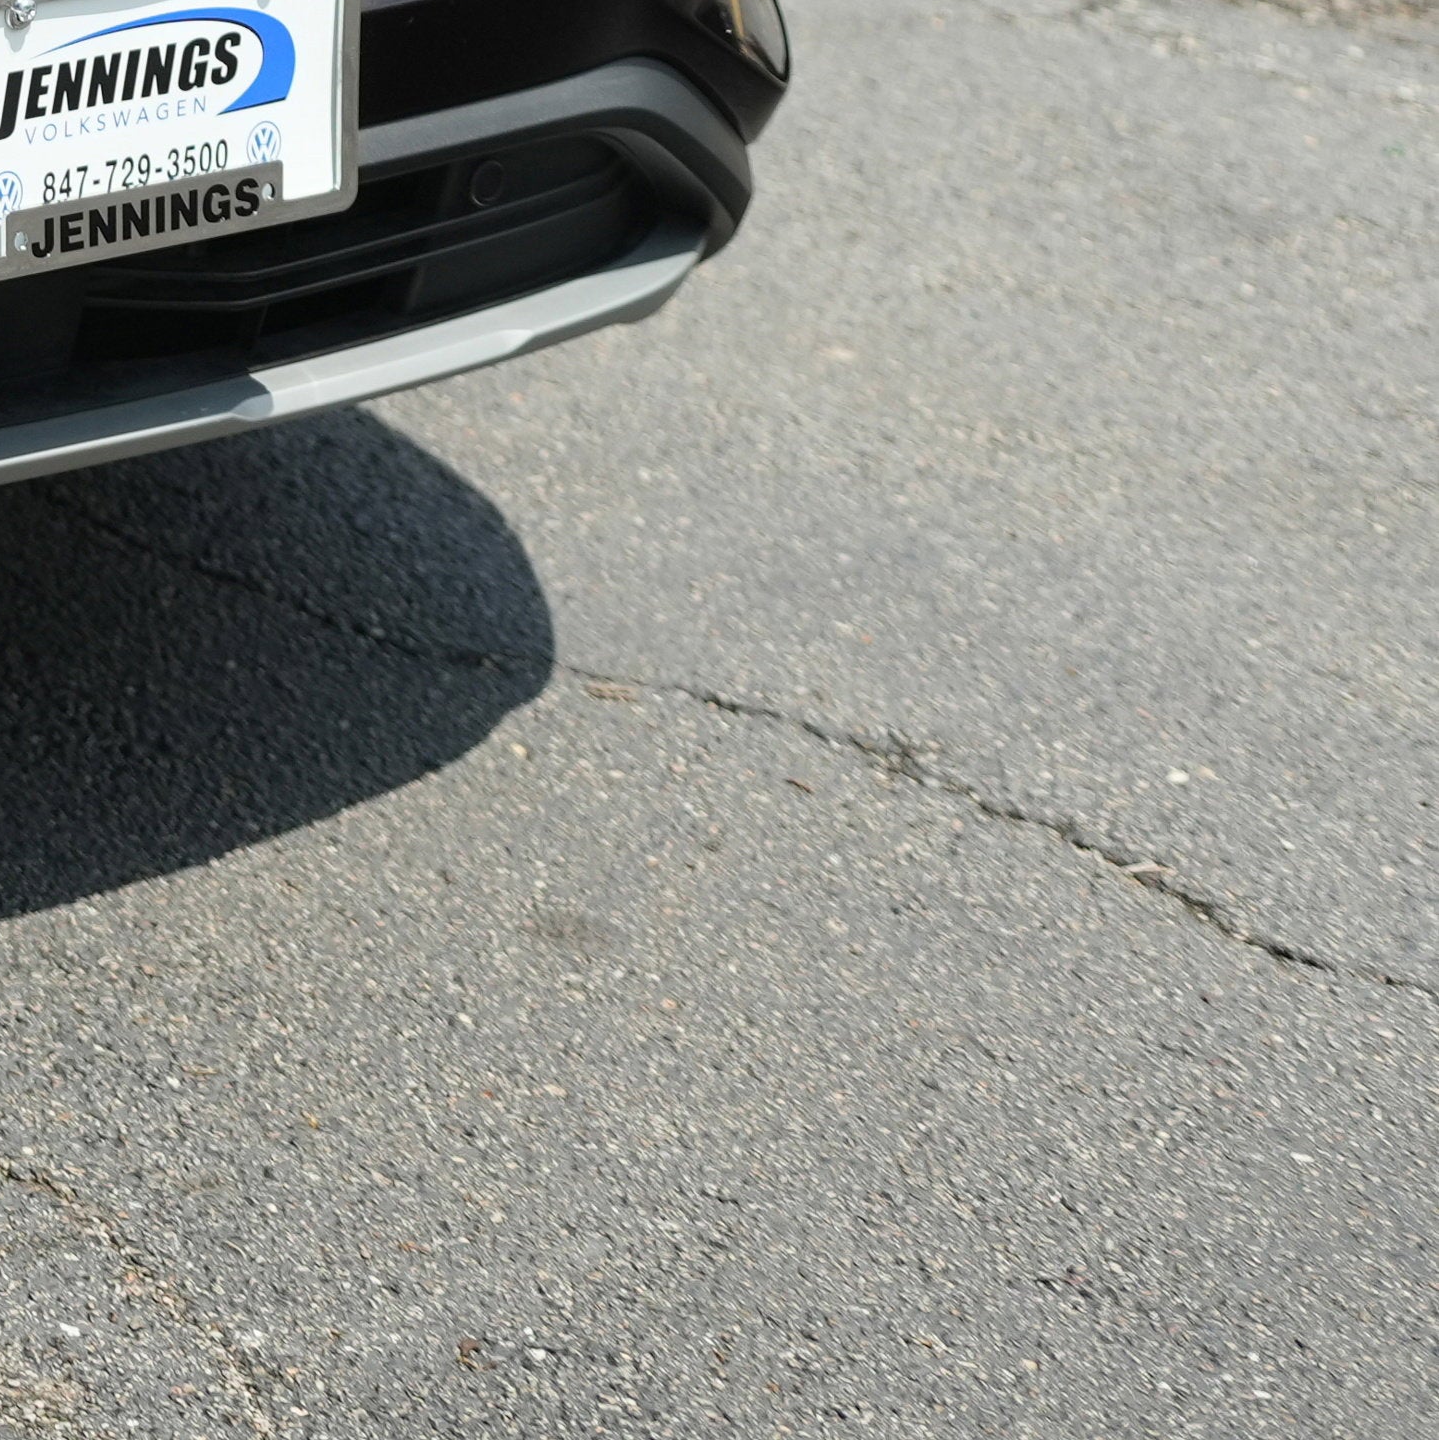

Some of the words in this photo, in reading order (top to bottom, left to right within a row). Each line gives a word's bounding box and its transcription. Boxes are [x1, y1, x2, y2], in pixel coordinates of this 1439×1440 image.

[25, 96, 207, 145] VOLKSWAGEN
[43, 139, 228, 204] 847-729-3500
[31, 177, 261, 258] JENNINGS
